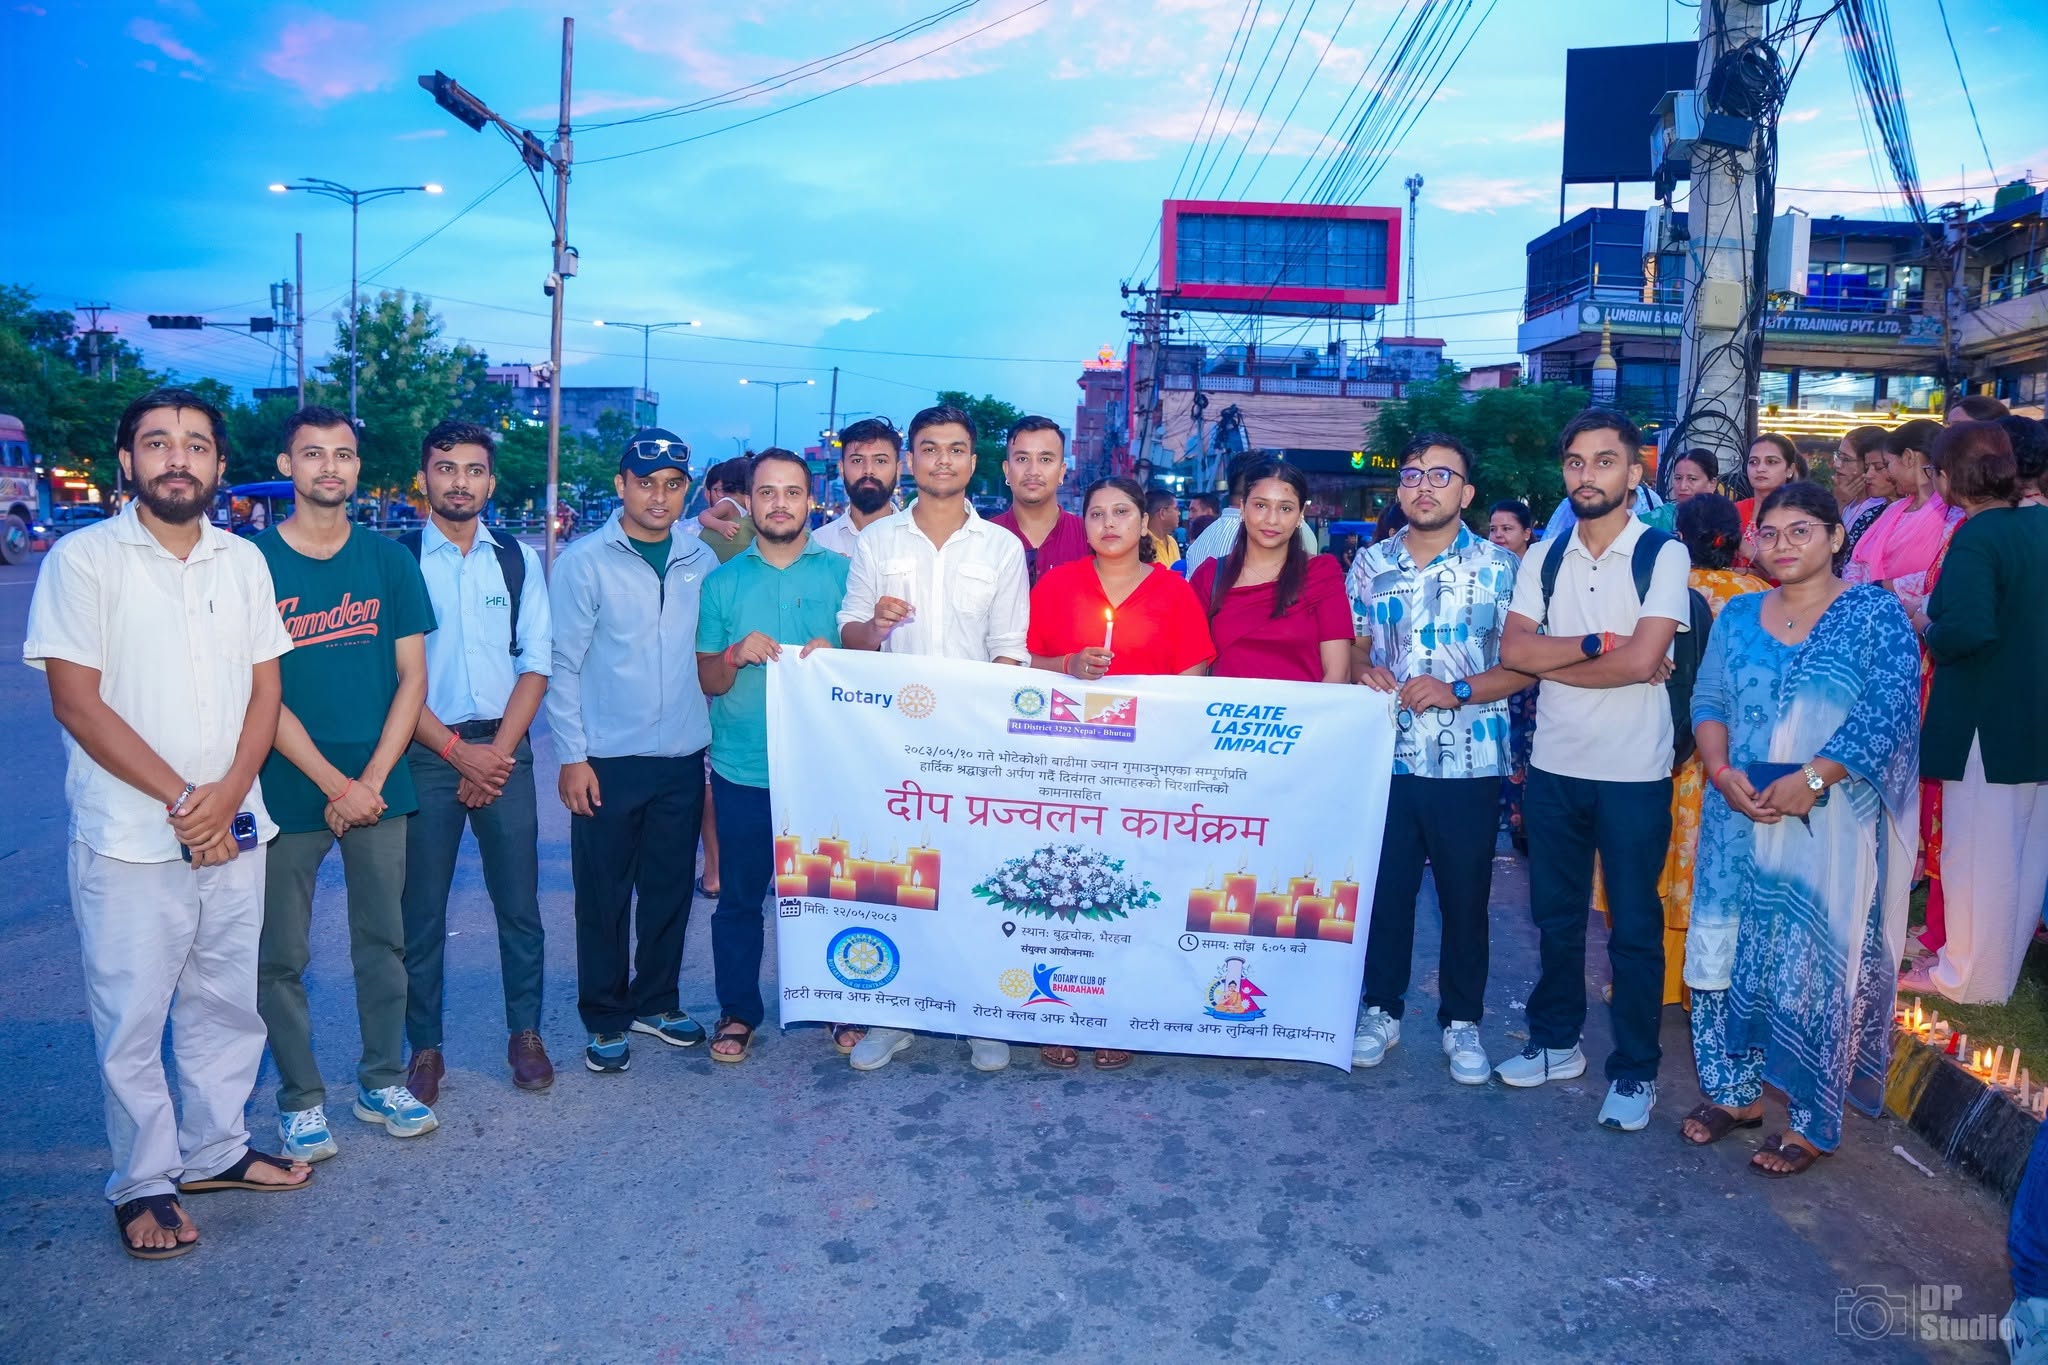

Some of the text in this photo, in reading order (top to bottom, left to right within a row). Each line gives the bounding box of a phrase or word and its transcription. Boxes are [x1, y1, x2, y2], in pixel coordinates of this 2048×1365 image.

[1605, 308, 1652, 324] LUMBINI
[1794, 317, 1848, 332] TRAINING
[1850, 319, 1875, 333] PVT.
[1878, 320, 1901, 333] LTD.
[486, 596, 508, 606] HFL
[831, 686, 893, 708] Rotary
[1206, 702, 1287, 721] CREATE
[1011, 721, 1021, 729] RI
[1023, 723, 1052, 732] District
[1054, 725, 1072, 733] 3292
[1074, 726, 1097, 736] Nepal
[1103, 729, 1131, 737] Bhutan
[1211, 720, 1303, 739] LASTING
[1214, 736, 1296, 756] IMPACT
[977, 749, 995, 762] गते
[1000, 751, 1047, 767] भोटेकोशी
[1051, 756, 1087, 769] बाढीमा
[1091, 759, 1118, 771] ज्यान
[1123, 762, 1191, 776] गुमाउनुभएका
[1195, 767, 1248, 781] सम्पूर्णप्रति
[919, 759, 953, 773] हार्दिक
[956, 764, 1002, 778] श्रद्धाञ्जली
[1006, 767, 1034, 780] अर्पण
[1059, 770, 1096, 785] दिवंगत
[1164, 780, 1229, 795] चिरशान्तिको
[1038, 786, 1102, 801] कामनासहित
[885, 780, 1270, 847] दीप प्रज्वलन कार्यक्रम
[833, 906, 898, 922] २२/०५/२०८३
[1099, 930, 1132, 944] भैरहवा
[1233, 939, 1255, 951] साँझ
[1261, 943, 1286, 953] ६:०५
[1290, 943, 1307, 954] बजे
[1021, 944, 1047, 955] संयुक्त
[1053, 974, 1107, 986] ROTARY CLUB OF
[1053, 983, 1105, 995] BHAIRAHAWA
[783, 985, 956, 1013] रोटरी क्लब अफ सेन्ट्रल लुम्बिनी
[972, 1003, 1107, 1028] रोटरी क्लब अफ भैरहवा
[1129, 1017, 1336, 1043] रोटरी क्लब अफ लुम्बिनी सिद्धार्थनगर
